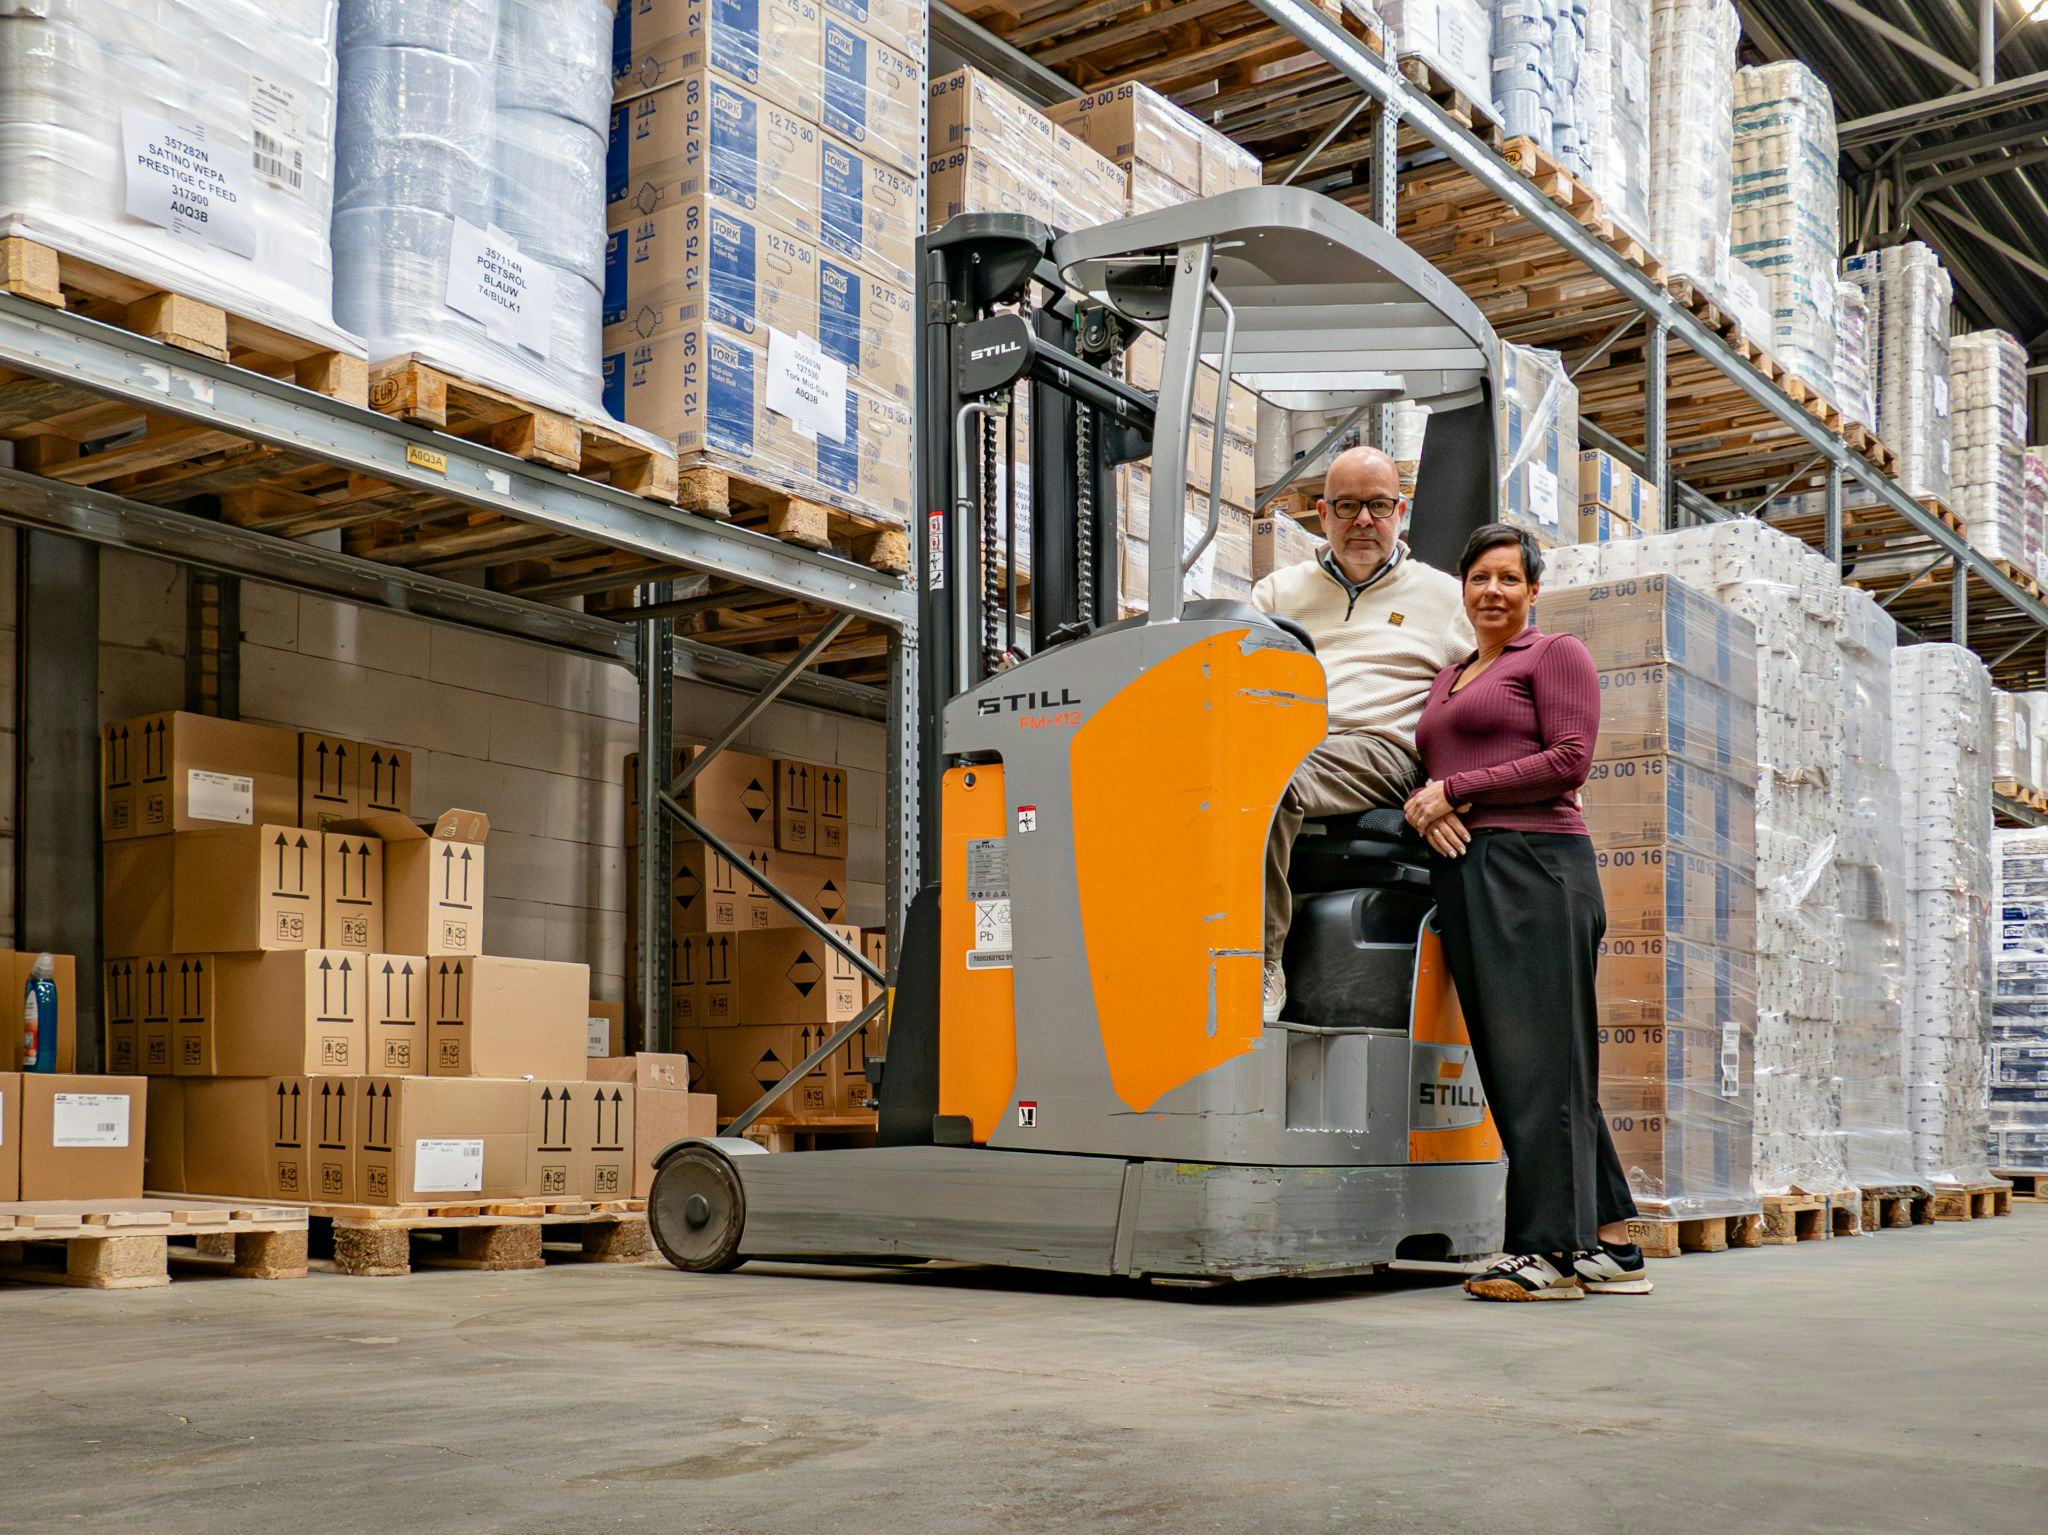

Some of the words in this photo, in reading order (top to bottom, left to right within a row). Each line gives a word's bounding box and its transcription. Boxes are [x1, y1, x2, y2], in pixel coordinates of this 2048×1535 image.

[802, 4, 815, 20] 30
[688, 12, 700, 37] 12
[829, 33, 852, 53] TORK
[878, 49, 888, 65] 12
[892, 57, 902, 73] 75
[906, 65, 916, 80] 30
[686, 80, 700, 104] 30
[931, 80, 947, 98] 02
[950, 75, 965, 91] 99
[715, 96, 740, 117] TORK
[1080, 96, 1094, 112] 29
[1098, 91, 1114, 106] 00
[1118, 85, 1134, 100] 59
[686, 110, 699, 136] 75
[769, 111, 781, 128] 12
[785, 119, 797, 135] 75
[800, 127, 813, 143] 30
[1029, 114, 1039, 128] 02
[1040, 121, 1050, 136] 99
[164, 135, 208, 163] 357282N
[686, 140, 699, 165] 12
[149, 143, 190, 169] SATINO
[193, 162, 226, 184] WEPA
[826, 154, 848, 172] TORK
[930, 158, 946, 175] 02
[949, 152, 965, 168] 99
[1096, 159, 1105, 172] 15
[1106, 166, 1115, 180] 02
[1116, 173, 1125, 187] 99
[138, 155, 196, 186] PRESTIGE
[198, 180, 206, 190] C
[208, 184, 237, 203] FEED
[873, 168, 885, 183] 12
[887, 174, 899, 190] 75
[901, 181, 913, 197] 30
[172, 184, 208, 207] 317900
[686, 205, 699, 230] 30
[715, 222, 739, 241] TORK
[484, 247, 522, 273] 357114N
[686, 236, 698, 262] 75
[768, 234, 780, 250] 12
[782, 240, 795, 256] 75
[798, 248, 811, 264] 30
[477, 256, 528, 290] POETSROL
[686, 265, 698, 291] 12
[824, 272, 846, 292] TORK
[484, 274, 519, 298] BLAUW
[478, 284, 520, 314] 74/BULK1
[870, 284, 882, 299] 12
[885, 290, 896, 305] 75
[899, 296, 910, 312] 30
[684, 332, 697, 357] 30
[970, 341, 1022, 360] STILL
[712, 347, 737, 366] TORK
[684, 362, 697, 388] 75
[786, 368, 801, 382] Tork
[374, 381, 393, 402] EUR
[684, 392, 697, 416] 12
[868, 400, 880, 414] 12
[883, 405, 894, 420] 75
[1584, 452, 1597, 462] 99
[1231, 508, 1240, 522] 00
[1242, 514, 1251, 527] 59
[1583, 506, 1596, 516] 99
[1258, 522, 1272, 535] 59
[1589, 587, 1610, 601] 29
[1616, 581, 1636, 597] 00
[1645, 576, 1663, 593] 16
[1614, 672, 1636, 688] 00
[1643, 668, 1663, 684] 16
[978, 688, 1081, 716] STILL
[1020, 710, 1081, 729] FM-X12
[1588, 764, 1608, 780] 29
[1614, 762, 1636, 778] 00
[1642, 760, 1662, 774] 16
[1614, 852, 1635, 866] 00
[1642, 850, 1662, 864] 16
[980, 931, 994, 942] Pb
[1614, 940, 1634, 955] 00
[1642, 940, 1662, 954] 16
[1614, 1029, 1636, 1044] 00
[1643, 1028, 1663, 1044] 16
[1420, 1083, 1480, 1107] STILL
[1612, 1118, 1634, 1132] 00
[1641, 1118, 1660, 1132] 16
